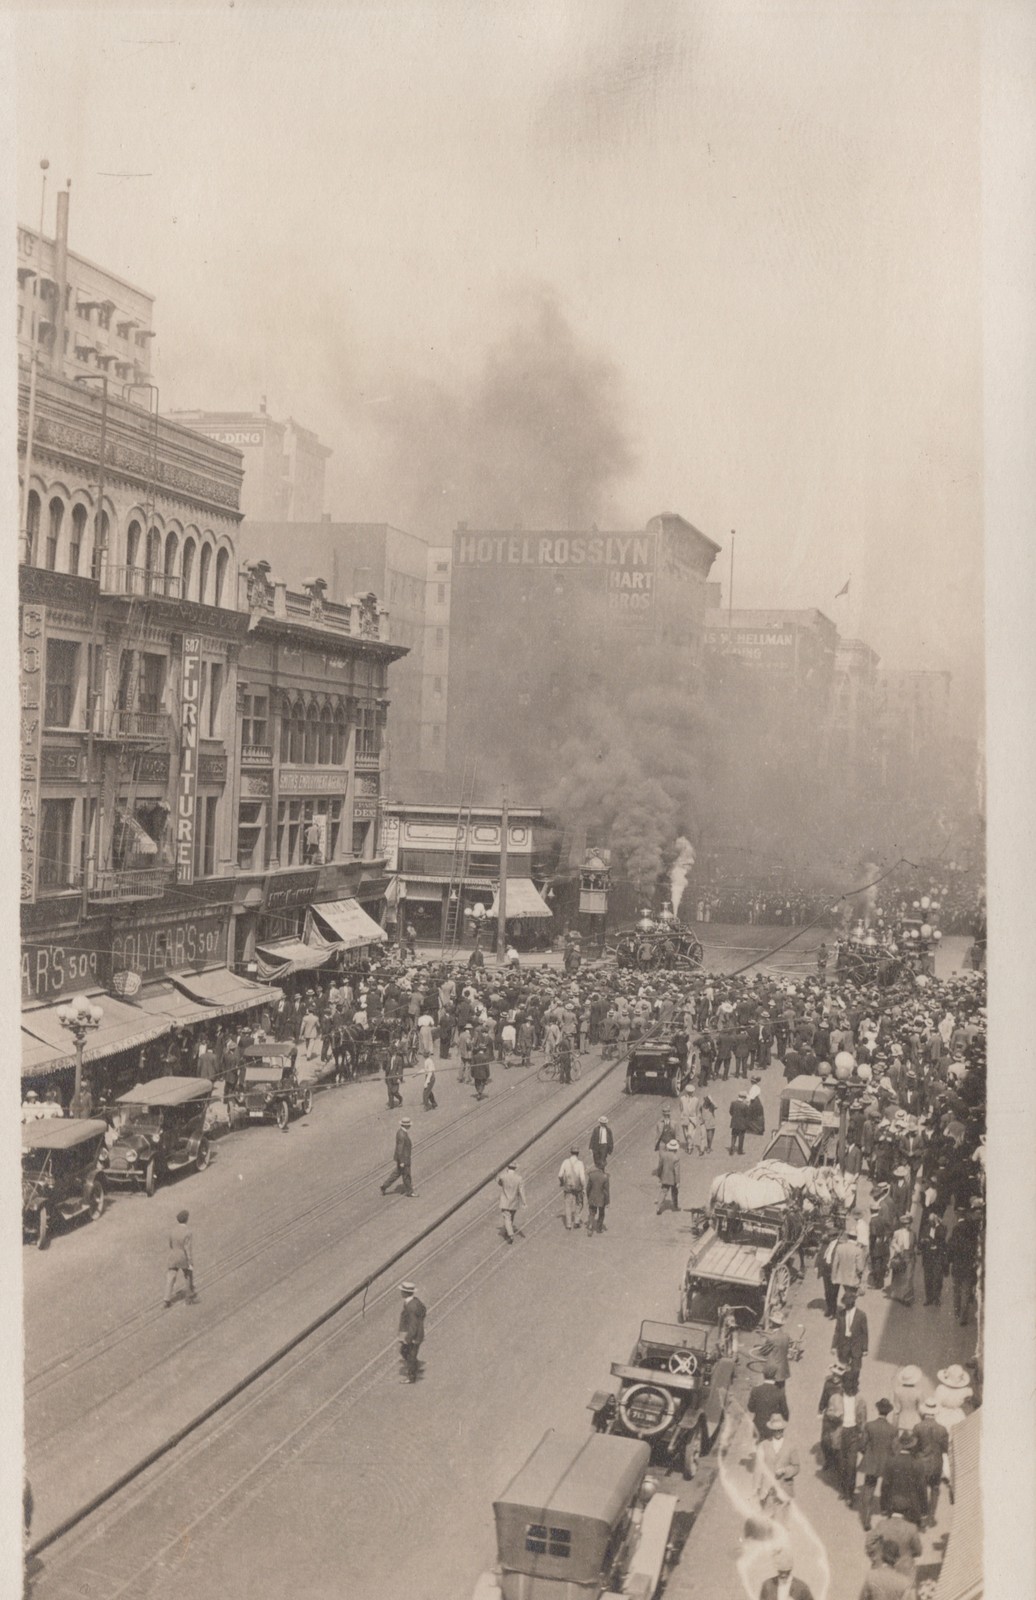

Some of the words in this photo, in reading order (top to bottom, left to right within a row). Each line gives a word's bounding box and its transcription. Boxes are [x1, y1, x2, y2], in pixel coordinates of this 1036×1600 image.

[206, 432, 260, 444] ILDING
[459, 536, 535, 564] HOTEL
[538, 537, 649, 565] ROSSLYN
[609, 571, 654, 589] HART
[184, 638, 200, 652] 507
[735, 634, 793, 646] HELLMAN
[178, 656, 199, 865] FURNITURE
[111, 923, 198, 974] COLYEAR'S
[199, 930, 220, 953] 507
[69, 951, 98, 979] 509
